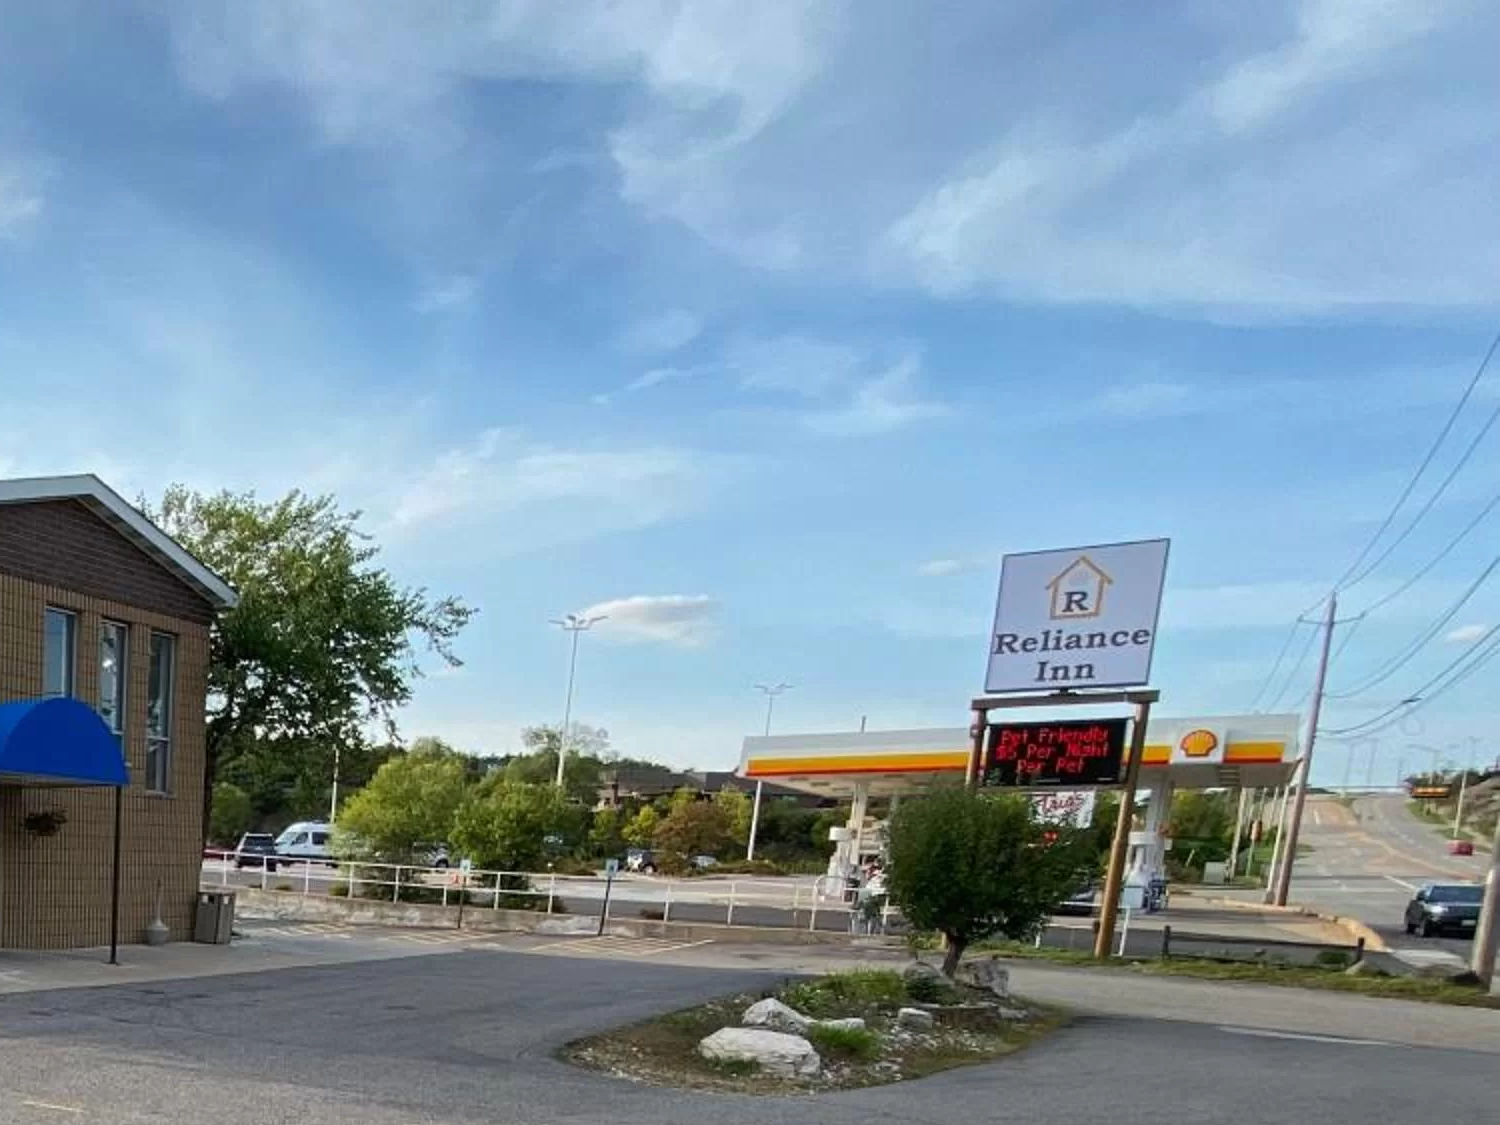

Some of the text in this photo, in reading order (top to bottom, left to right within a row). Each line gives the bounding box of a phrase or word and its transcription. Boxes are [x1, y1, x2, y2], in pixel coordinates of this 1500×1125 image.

[1061, 591, 1089, 613] R
[993, 628, 1151, 655] Reliance
[1034, 661, 1095, 682] Inn
[1001, 727, 1109, 746] Pet Friendly
[1026, 744, 1053, 759] Per
[1016, 757, 1086, 774] Per Pet
